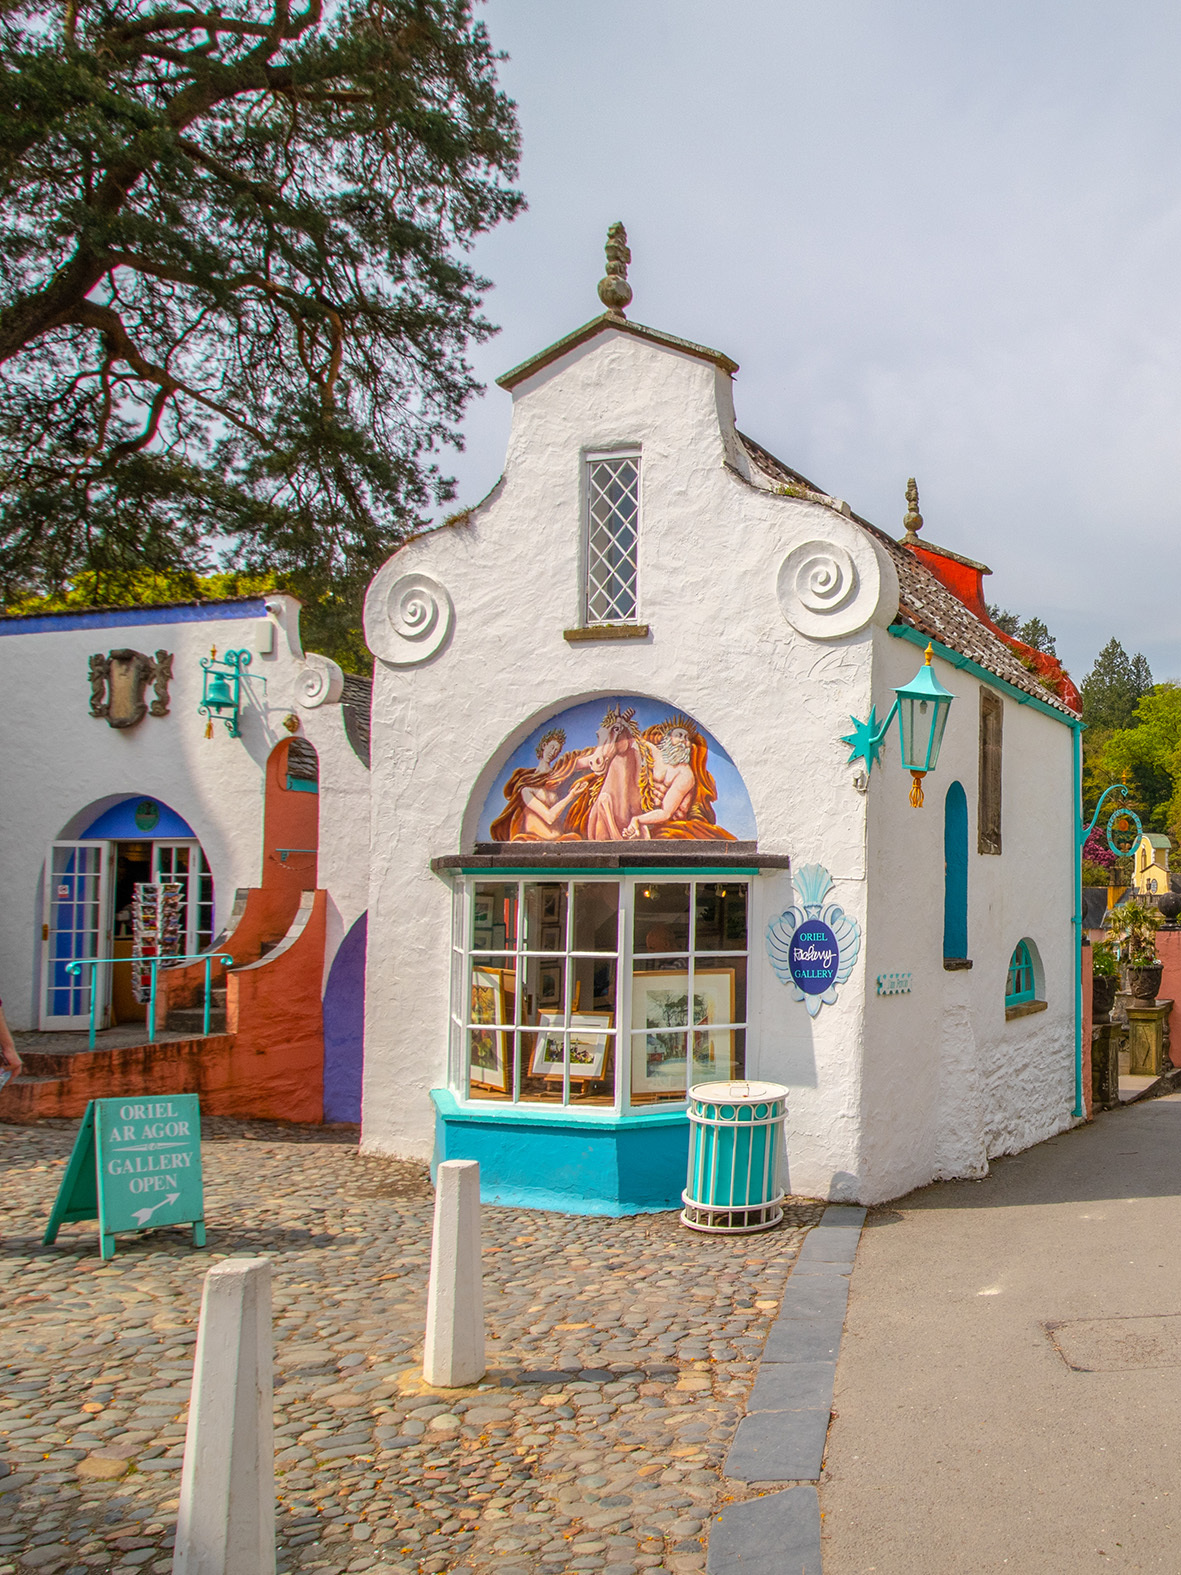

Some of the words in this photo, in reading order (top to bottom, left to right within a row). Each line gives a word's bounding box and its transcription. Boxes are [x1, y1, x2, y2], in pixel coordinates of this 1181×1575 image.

[800, 932, 828, 941] ORIEL
[794, 969, 833, 979] GALLERY
[119, 1102, 178, 1121] ORIEL
[109, 1125, 136, 1142] AR
[141, 1121, 191, 1140] AGOR
[107, 1152, 193, 1175] GALLERY
[129, 1173, 177, 1194] OPEN
